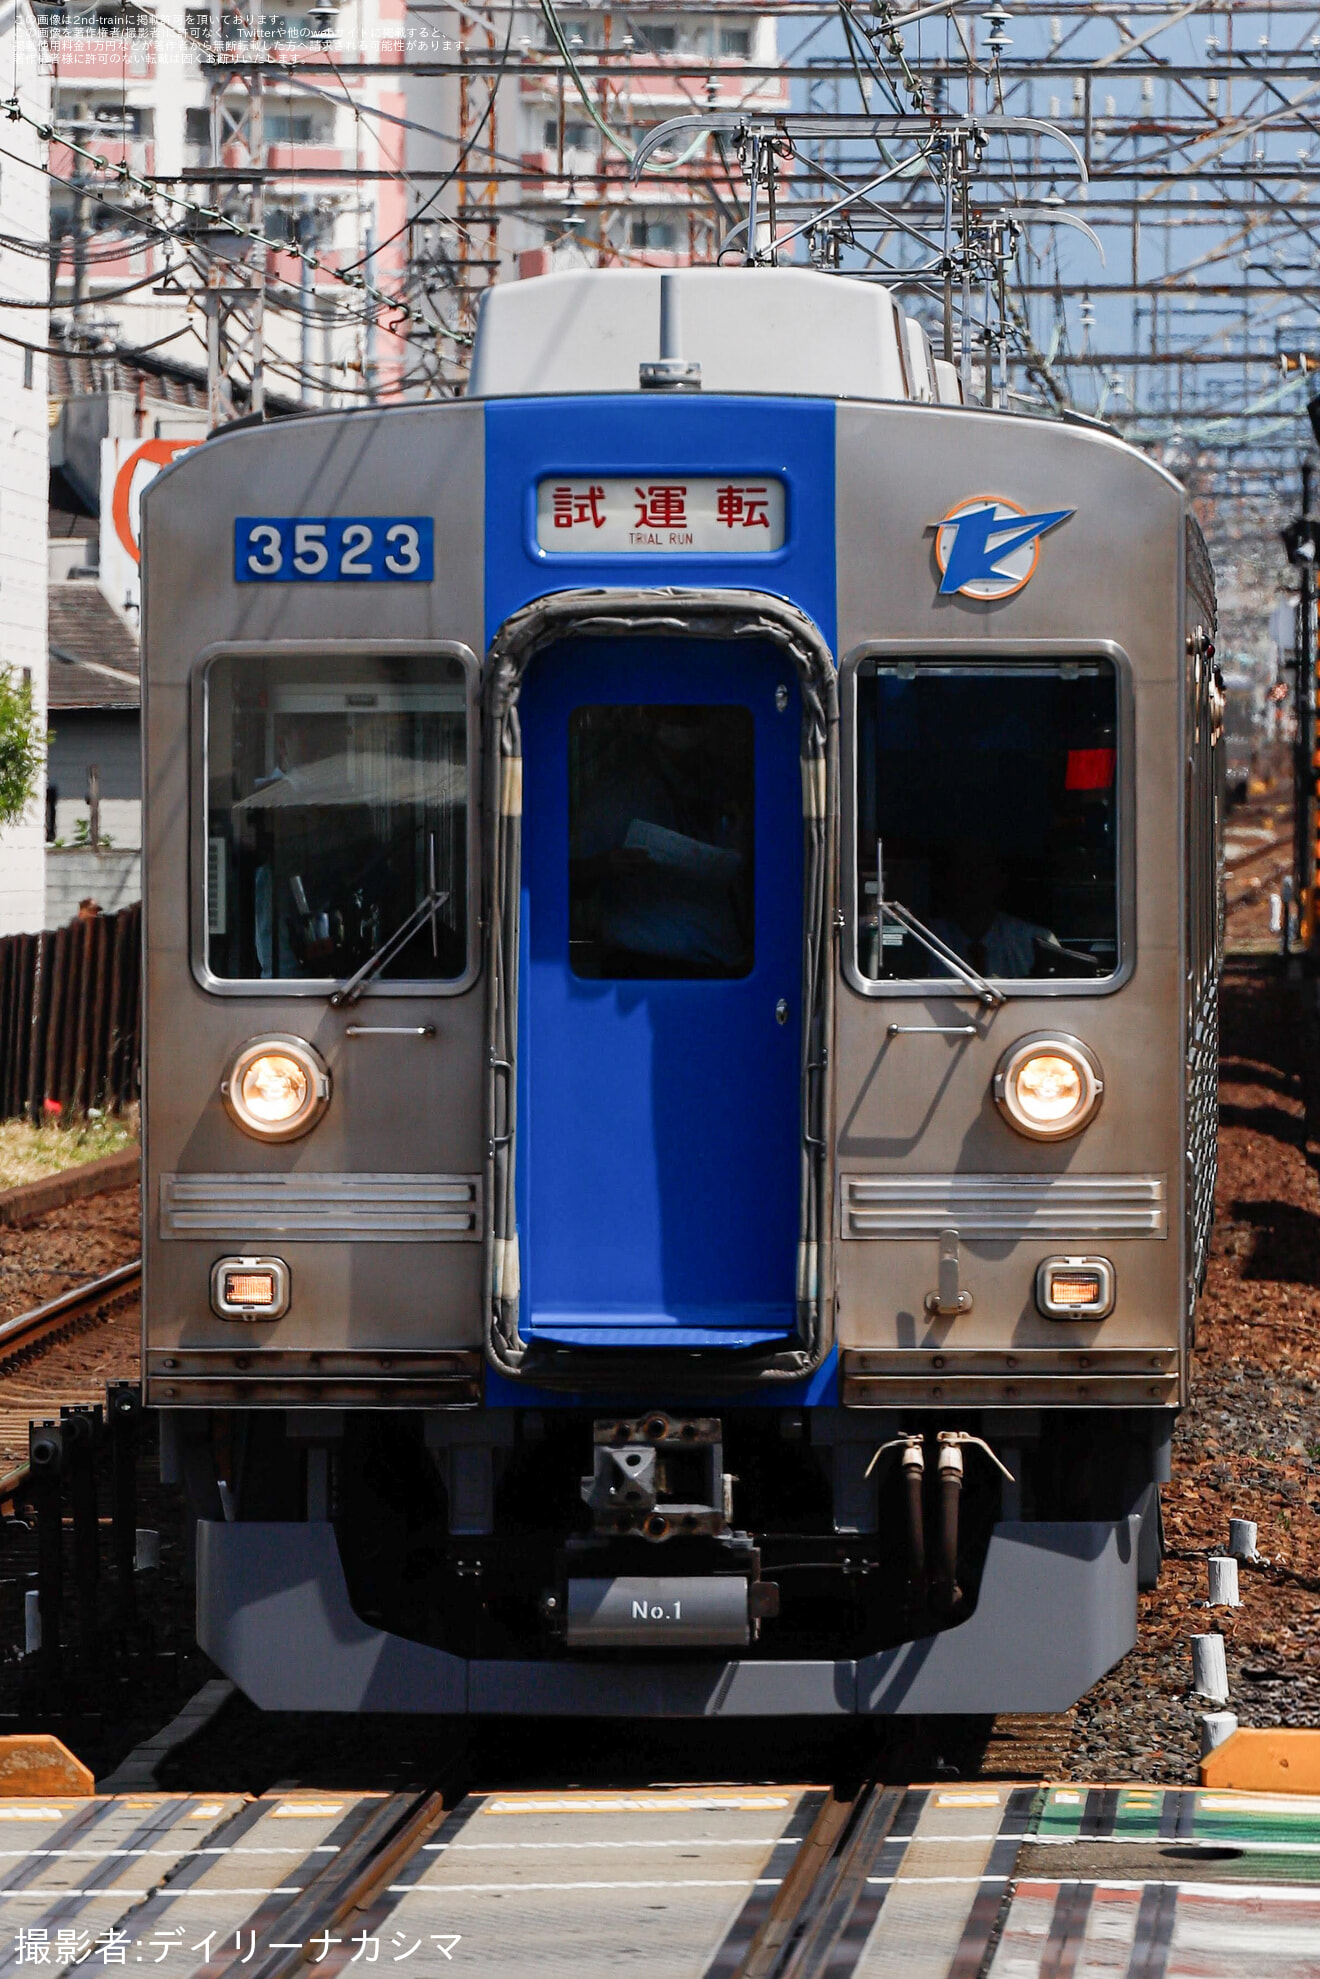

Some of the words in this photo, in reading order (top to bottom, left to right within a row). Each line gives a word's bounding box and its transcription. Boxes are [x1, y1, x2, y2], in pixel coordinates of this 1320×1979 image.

[553, 485, 770, 529] 試運転
[248, 524, 421, 575] 3523
[629, 532, 662, 545] TRIAL
[669, 532, 693, 545] RUN
[632, 1600, 681, 1620] No.1
